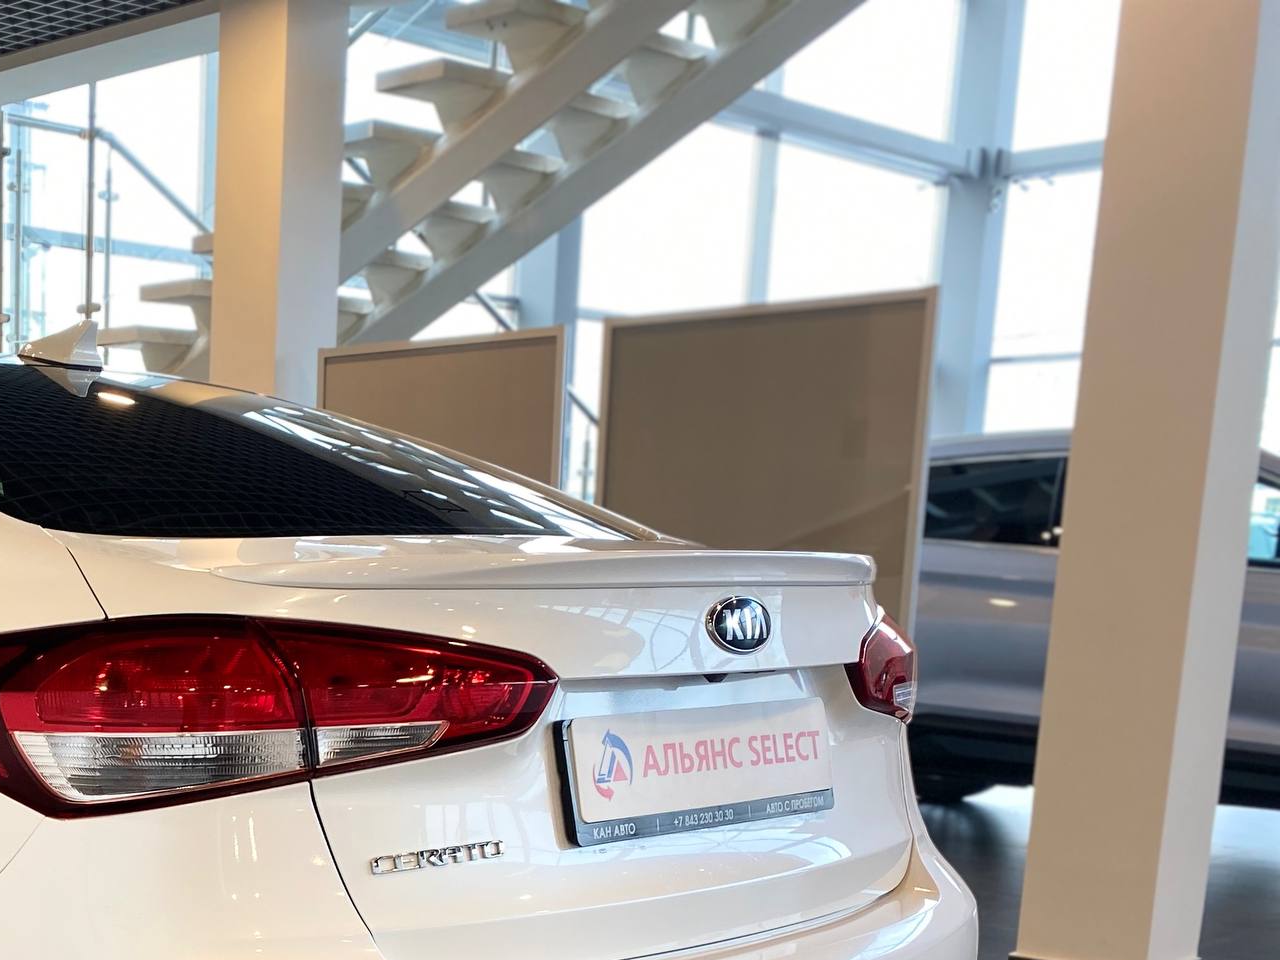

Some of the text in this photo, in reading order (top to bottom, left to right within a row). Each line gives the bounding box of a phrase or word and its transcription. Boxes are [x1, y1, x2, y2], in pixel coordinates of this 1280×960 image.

[723, 606, 768, 641] KIA
[642, 730, 820, 778] АЛЬЯНС SELECT
[593, 826, 612, 839] КАН
[613, 822, 636, 837] АВТО
[673, 816, 683, 828] +7
[685, 814, 699, 826] 843
[700, 811, 713, 824] 230
[714, 810, 724, 822] 30
[725, 808, 734, 820] 30
[766, 802, 784, 814] АВТО
[370, 839, 505, 875] CERATO
